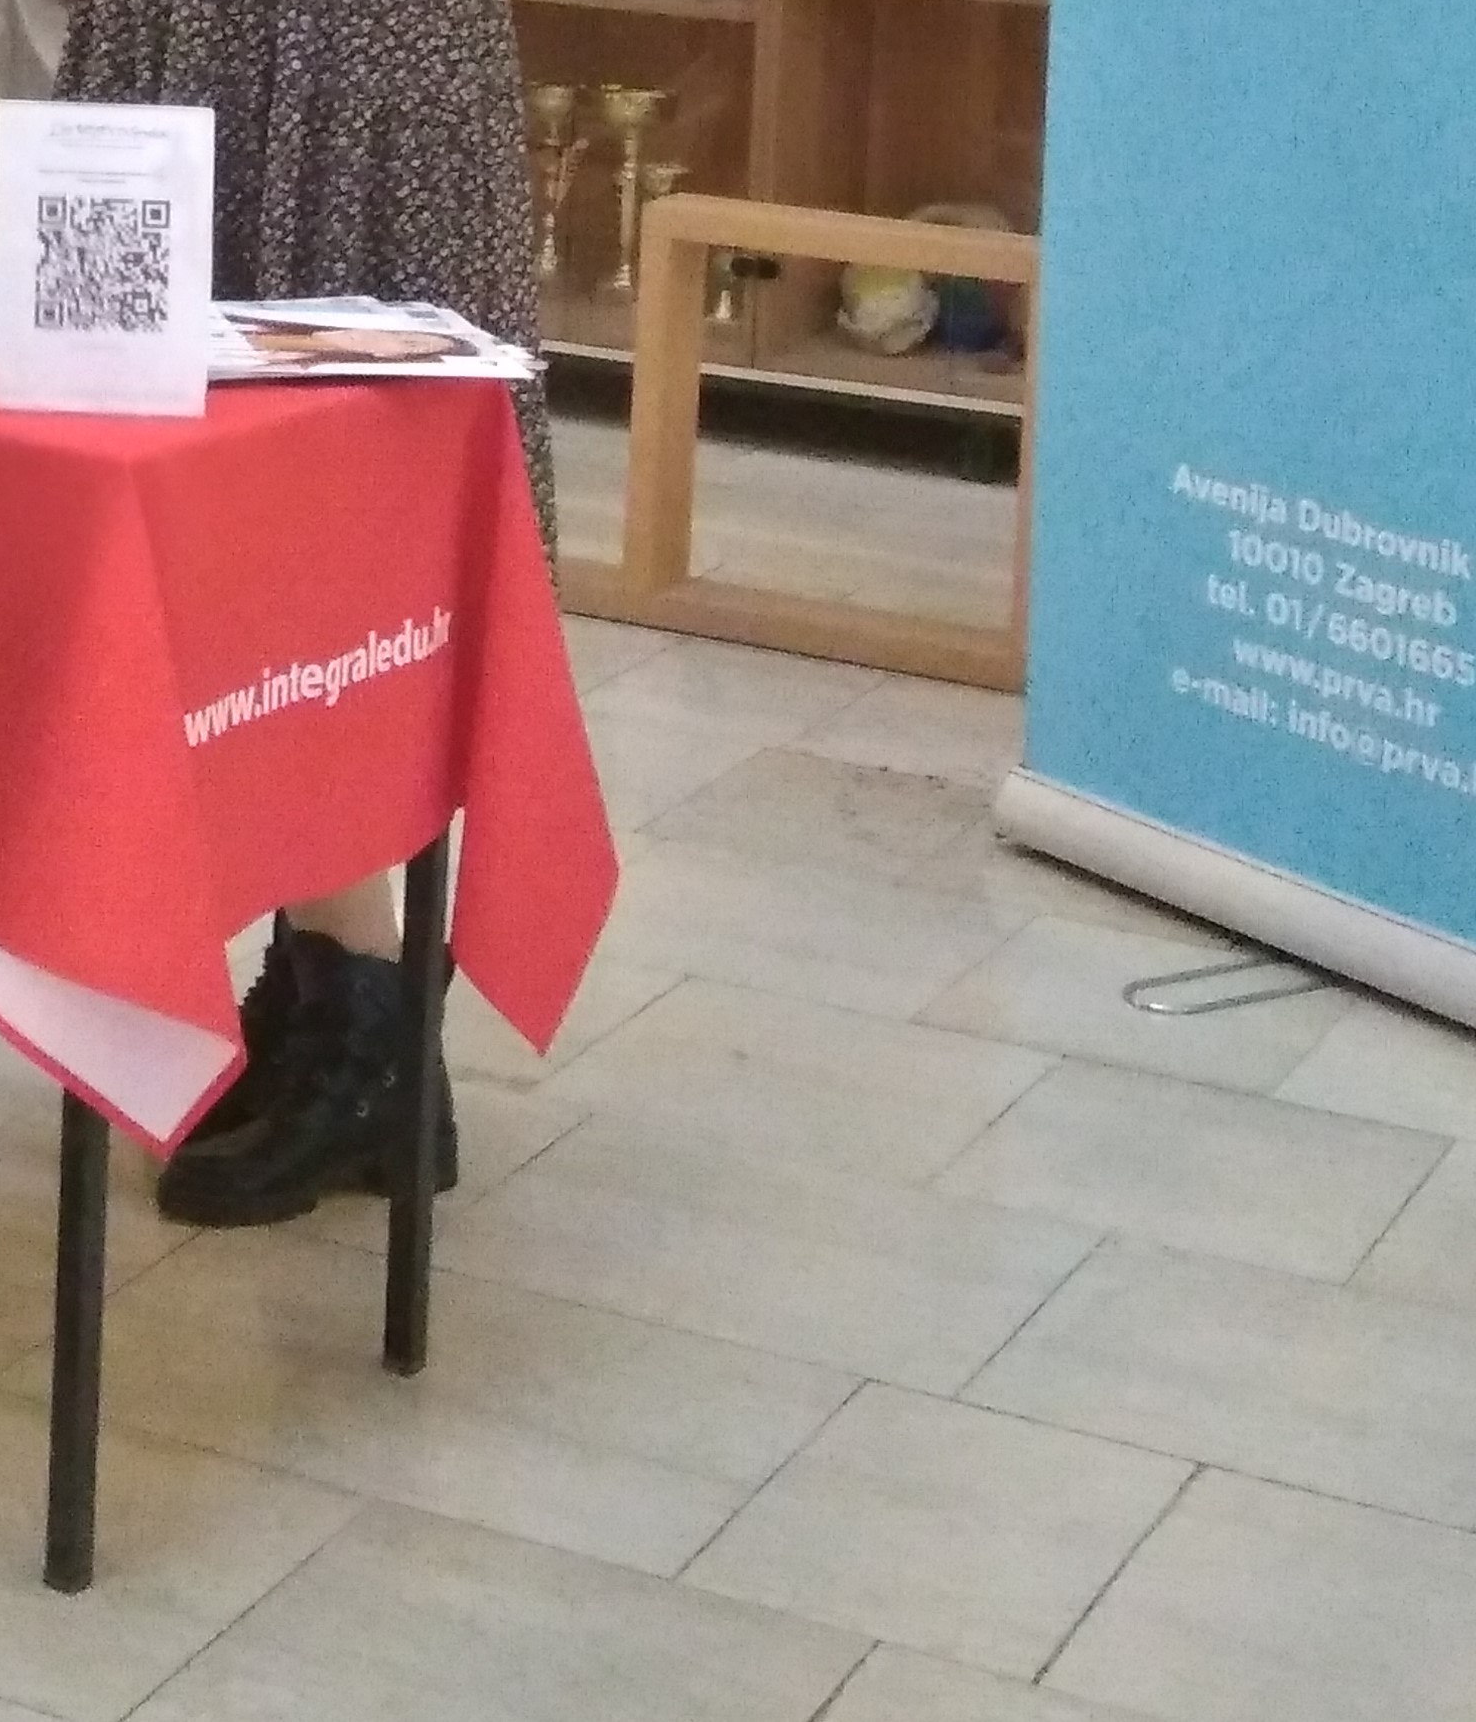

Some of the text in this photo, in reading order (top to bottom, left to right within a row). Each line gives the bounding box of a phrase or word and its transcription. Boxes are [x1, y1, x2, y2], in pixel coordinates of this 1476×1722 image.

[1169, 463, 1472, 580] Avenija Dubrovnik
[1207, 574, 1255, 615] tel.
[1228, 529, 1457, 627] 10010 Zagreb
[183, 605, 452, 748] www.integraledu.hr
[1232, 638, 1442, 728] www.prva.hr
[1171, 667, 1476, 795] e-mail: info@prva.
